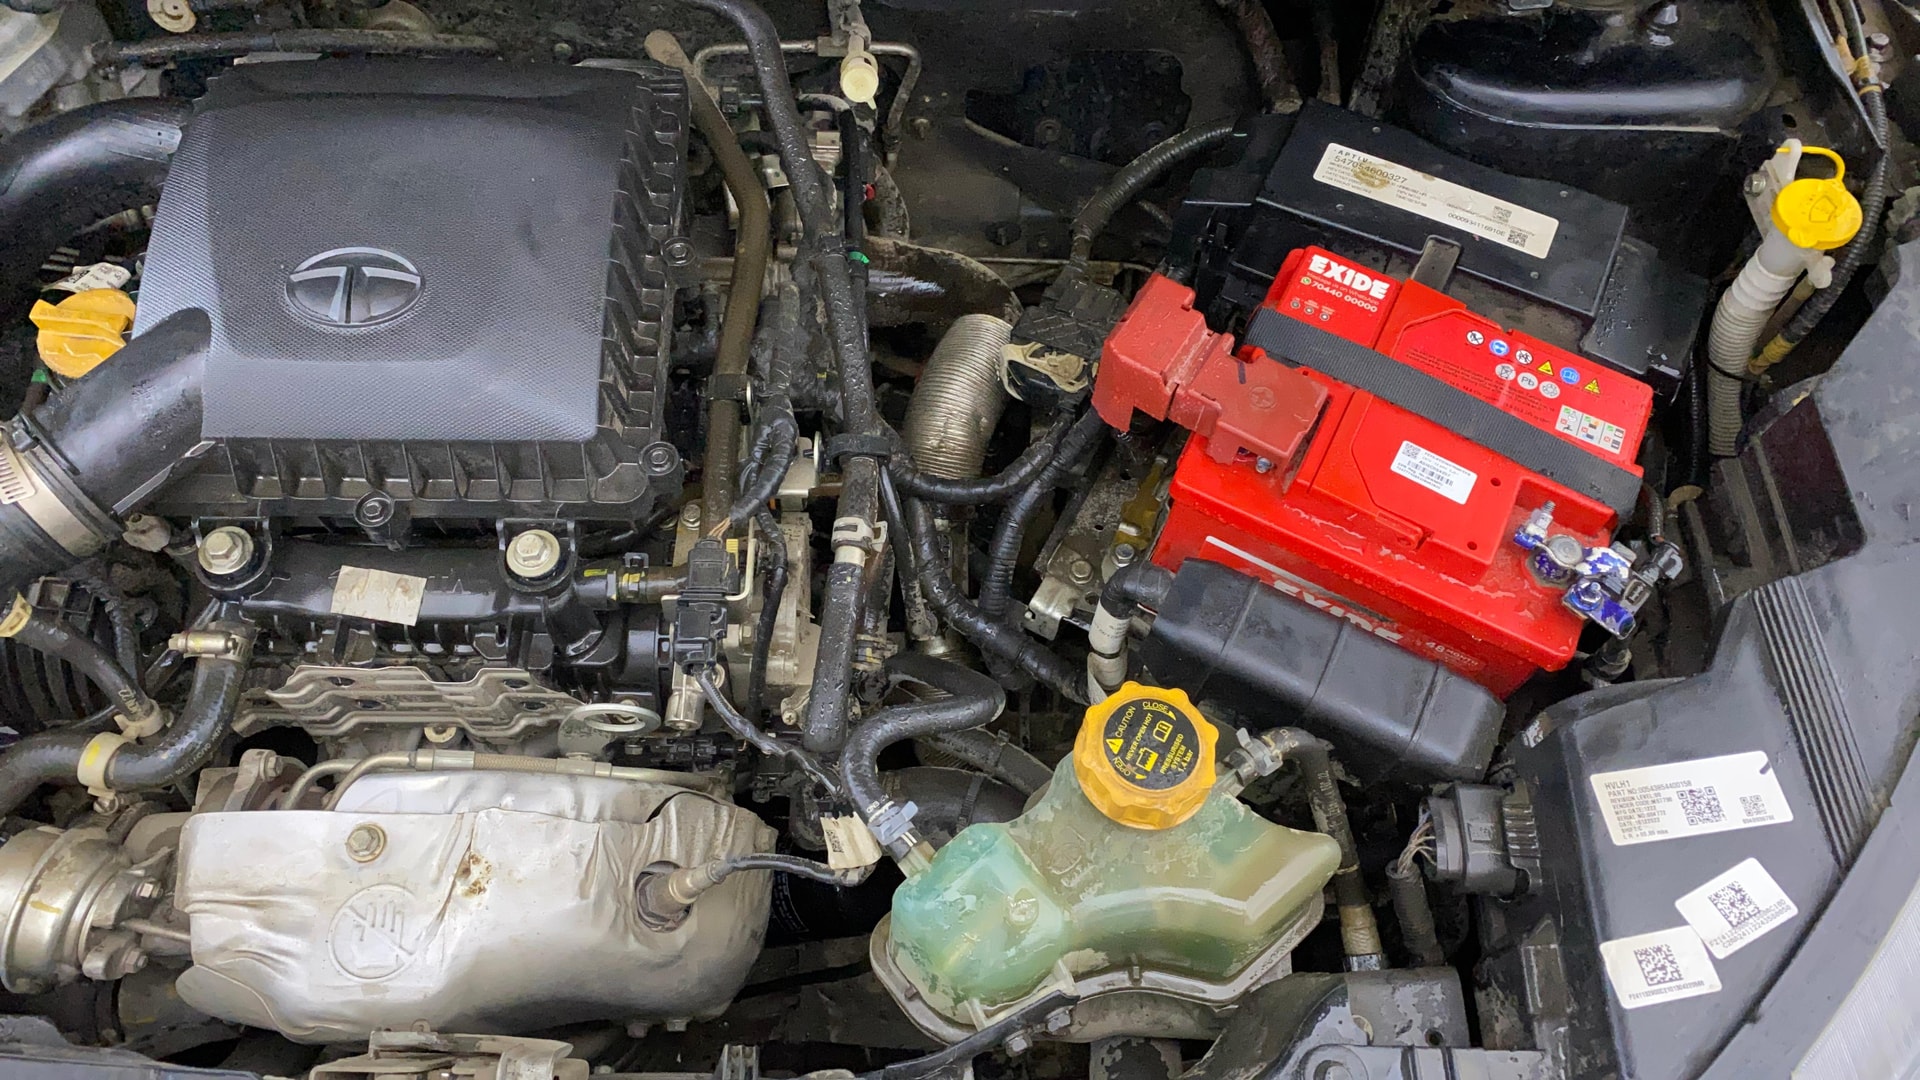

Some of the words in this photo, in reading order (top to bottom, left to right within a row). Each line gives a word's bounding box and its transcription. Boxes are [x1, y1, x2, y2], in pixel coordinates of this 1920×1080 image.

[1308, 254, 1390, 300] EXIDE
[1311, 280, 1343, 298] 70440
[1344, 294, 1377, 312] 00000
[1522, 376, 1535, 386] Pb
[1425, 641, 1445, 653] 48
[1142, 701, 1169, 712] CLOSE
[1115, 705, 1137, 738] CAUTION
[1125, 740, 1138, 760] NEVER
[1135, 725, 1147, 741] OPEN
[1144, 712, 1154, 726] HOT
[1160, 733, 1184, 774] PRESSURISED
[1171, 745, 1187, 769] SYSTEM
[1113, 756, 1131, 776] OPEN
[1604, 780, 1631, 790] HVLH1
[1607, 789, 1626, 798] PART
